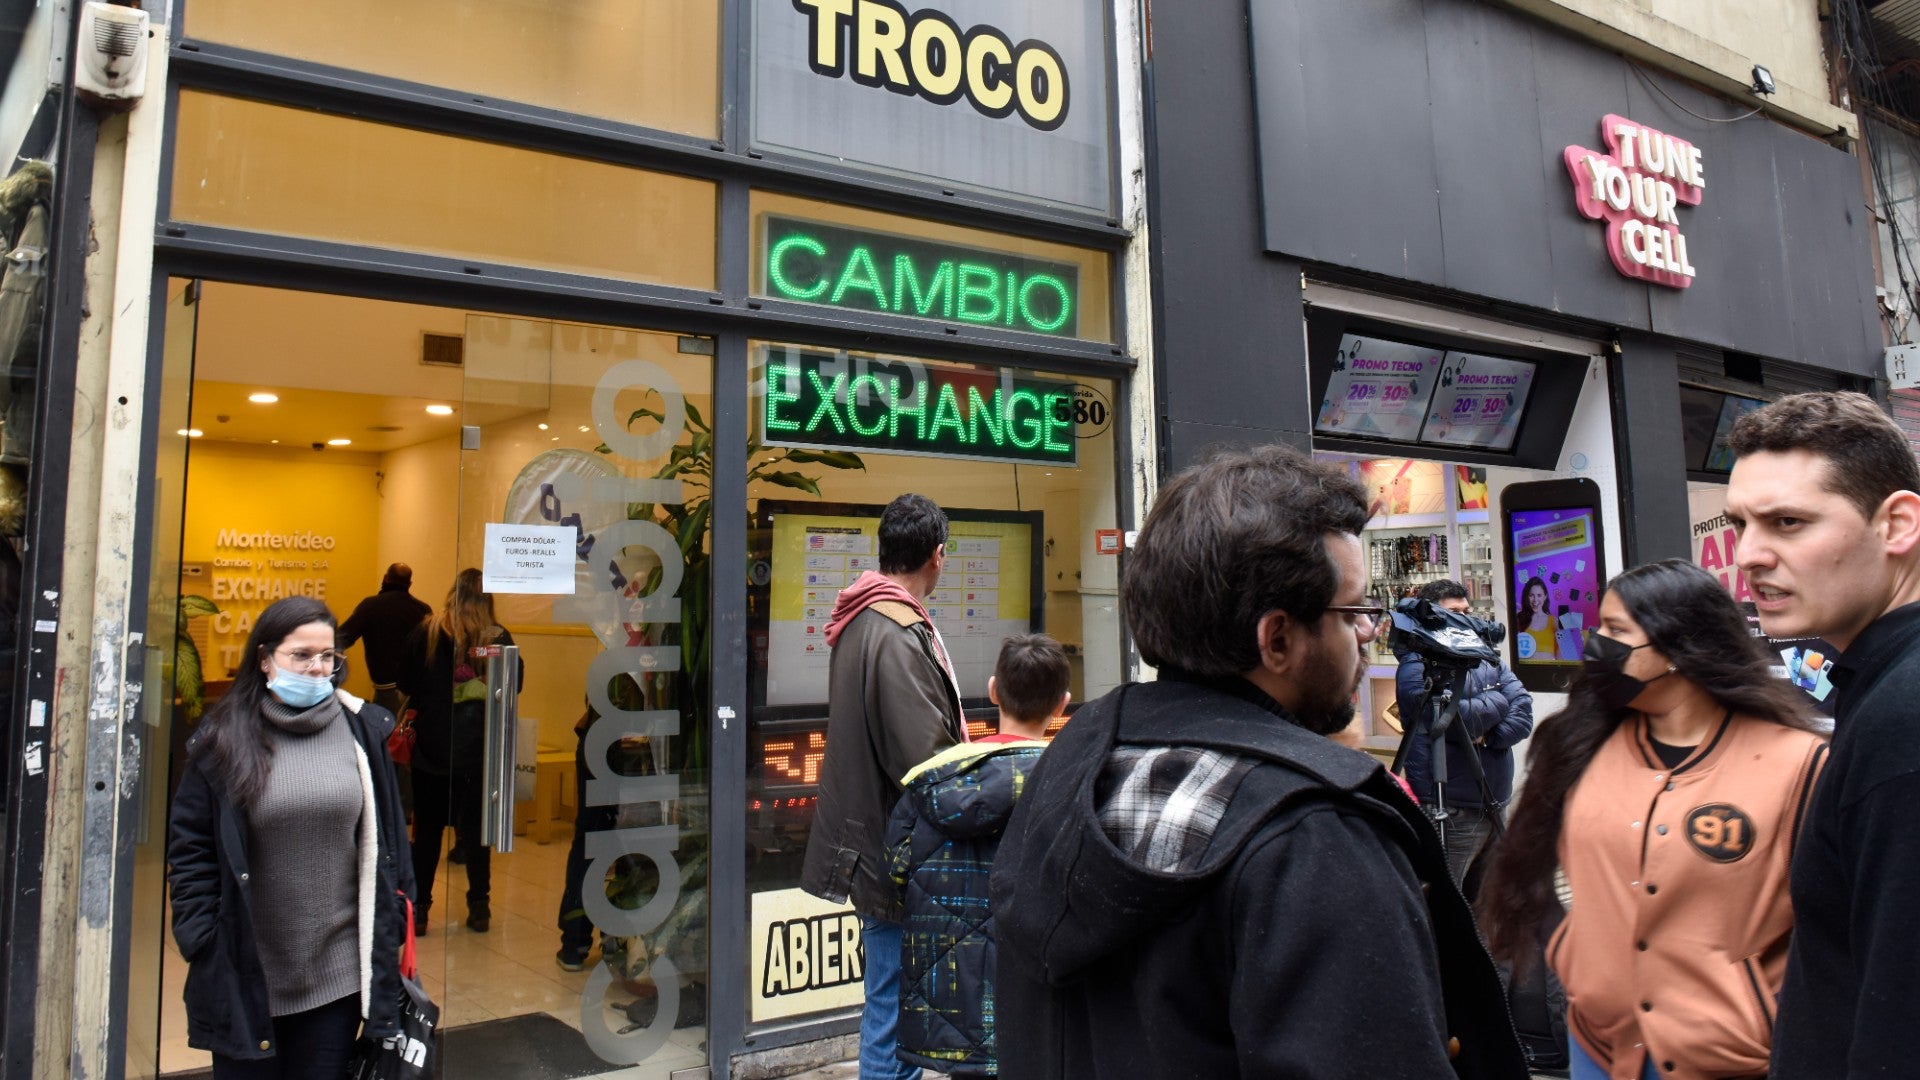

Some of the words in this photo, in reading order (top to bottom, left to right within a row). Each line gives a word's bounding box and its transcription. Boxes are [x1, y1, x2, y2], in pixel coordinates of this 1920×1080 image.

[796, 0, 1069, 128] TROCO
[1614, 124, 1705, 188] TUNE
[1583, 155, 1679, 225] YOUR
[1622, 219, 1696, 277] CELL
[770, 236, 1070, 331] CAMBIO
[1352, 359, 1389, 371] PROMO
[1391, 361, 1423, 371] TECNO
[1458, 374, 1489, 384] PROMO
[1491, 375, 1518, 385] TECNO
[766, 365, 1070, 452] EXCHANGE
[1056, 397, 1106, 425] 580
[213, 557, 252, 567] Cambio
[257, 561, 264, 571] y
[268, 559, 307, 568] Turismo
[217, 528, 336, 550] Montevideo
[213, 577, 327, 600] EXCHANGE
[552, 359, 686, 1065] cambio
[1692, 815, 1744, 852] 91
[763, 911, 865, 998] ABIER
